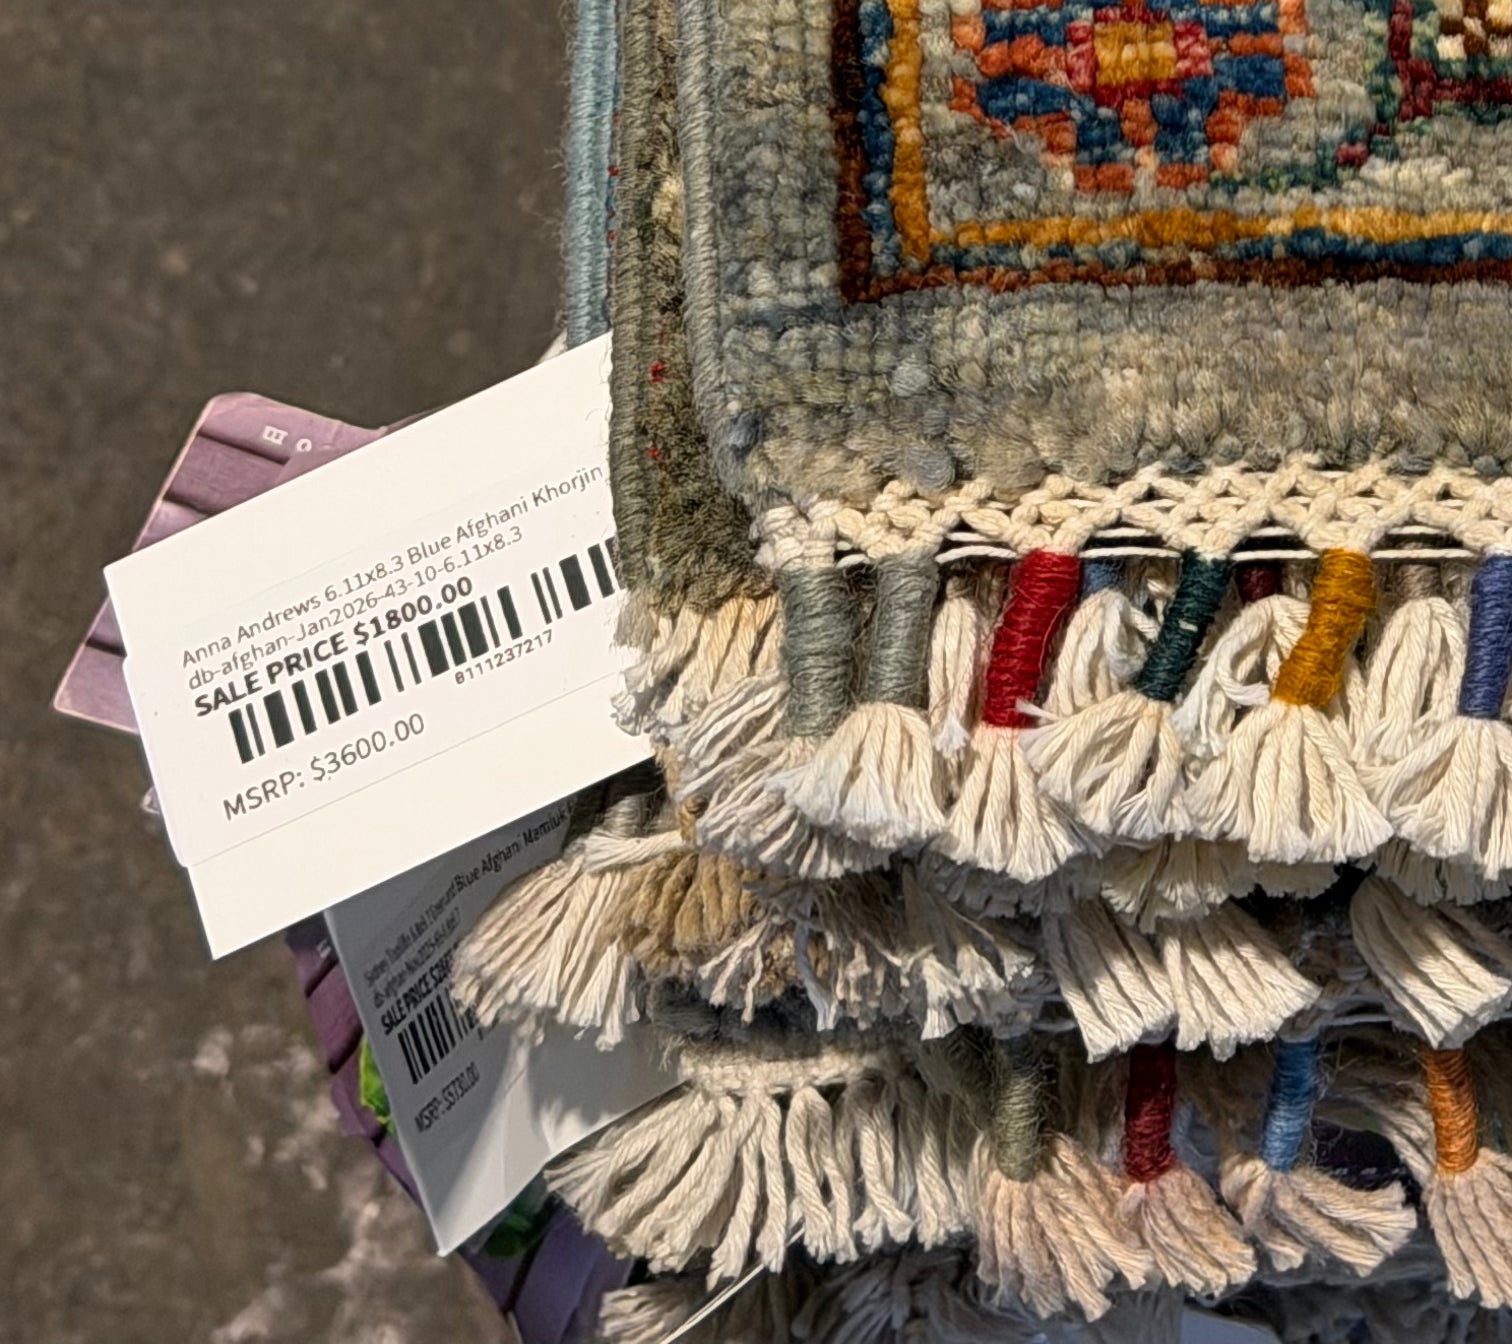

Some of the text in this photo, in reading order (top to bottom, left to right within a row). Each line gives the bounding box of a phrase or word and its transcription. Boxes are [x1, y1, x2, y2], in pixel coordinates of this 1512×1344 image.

[182, 466, 604, 668] Anna Andrews 6.11x8.3 Blue Afghani Khorjin
[188, 525, 524, 690] db-afghan-Jan2026-43-10-6.11x8.3
[194, 576, 473, 717] SALE PRICE $1800.00
[223, 712, 426, 820] MSRP: $3600.00
[454, 868, 480, 892] Blue
[481, 833, 521, 873] Afghani
[381, 974, 433, 1036] SALE PRICE
